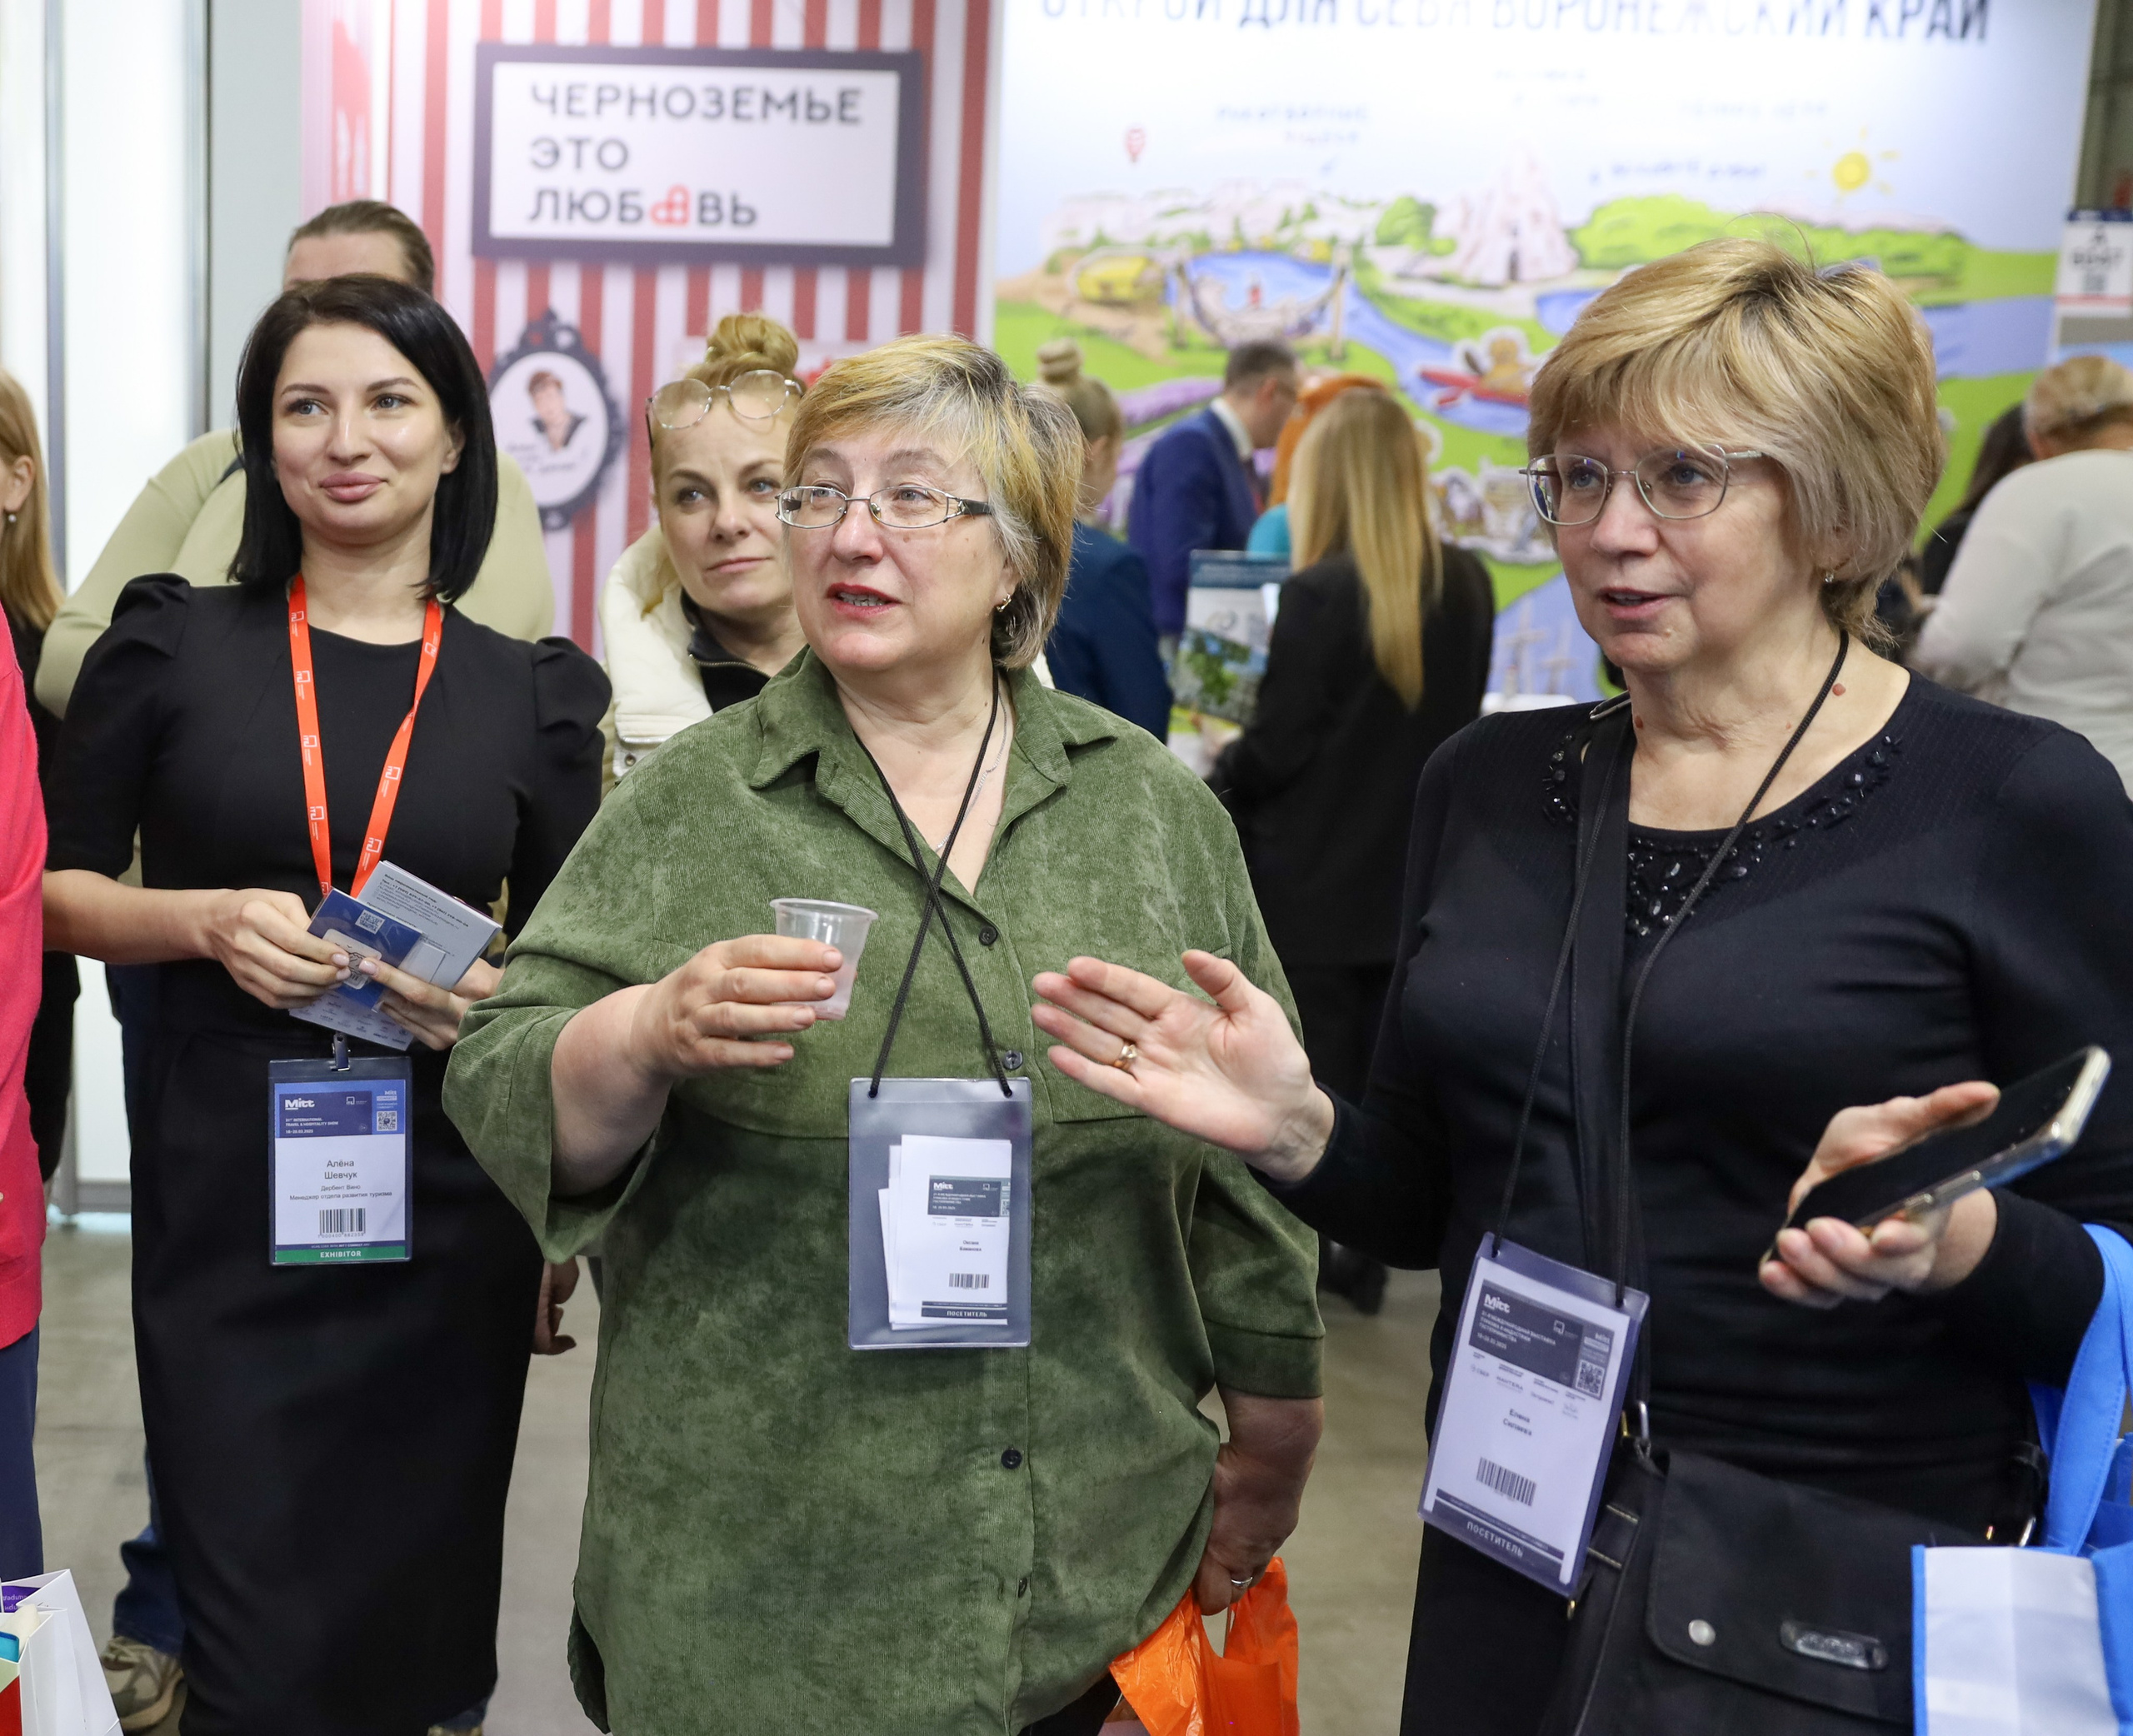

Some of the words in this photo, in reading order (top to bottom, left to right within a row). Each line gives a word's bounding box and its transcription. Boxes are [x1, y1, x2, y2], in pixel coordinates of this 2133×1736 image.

[531, 83, 862, 123] ЧЕРНОЗЕМЬЕ
[530, 137, 629, 171] ЭТО
[285, 1097, 315, 1110] Mitt
[324, 1171, 357, 1180] Шевчук
[933, 1181, 954, 1190] Mitt
[1483, 1294, 1510, 1314] Mitt
[947, 1309, 987, 1318] ПОСЕТИТЕЛЬ
[1466, 1521, 1524, 1558] ПОСЕТИТЕЛЬ
